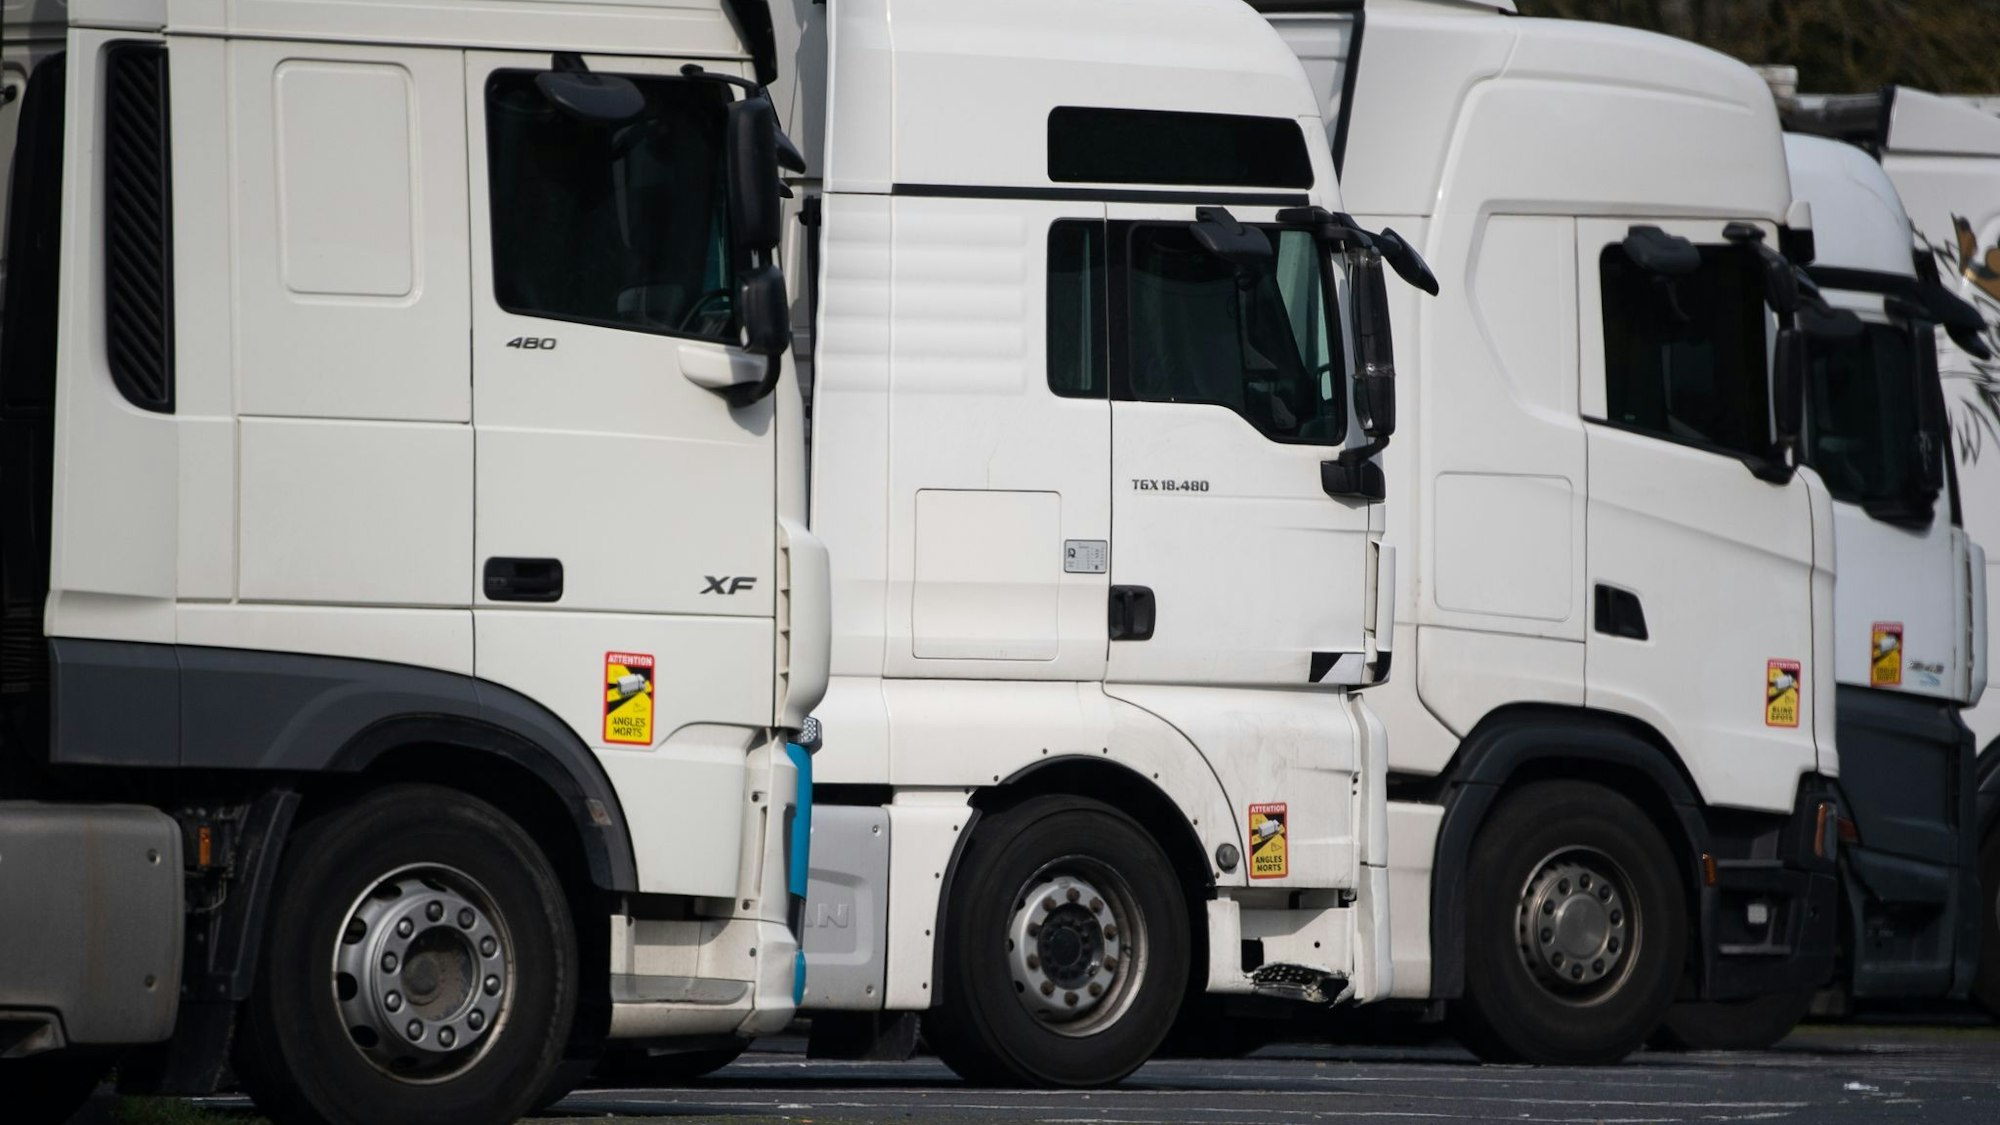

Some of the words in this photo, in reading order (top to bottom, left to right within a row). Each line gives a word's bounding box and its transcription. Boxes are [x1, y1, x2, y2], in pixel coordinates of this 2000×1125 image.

[506, 337, 557, 350] 480
[700, 575, 757, 595] XF
[608, 654, 653, 666] ATTENTION
[612, 717, 646, 728] ANGLES
[613, 726, 643, 738] MORTS
[1251, 805, 1285, 813] ATTENTION
[1256, 856, 1282, 864] ANGLES
